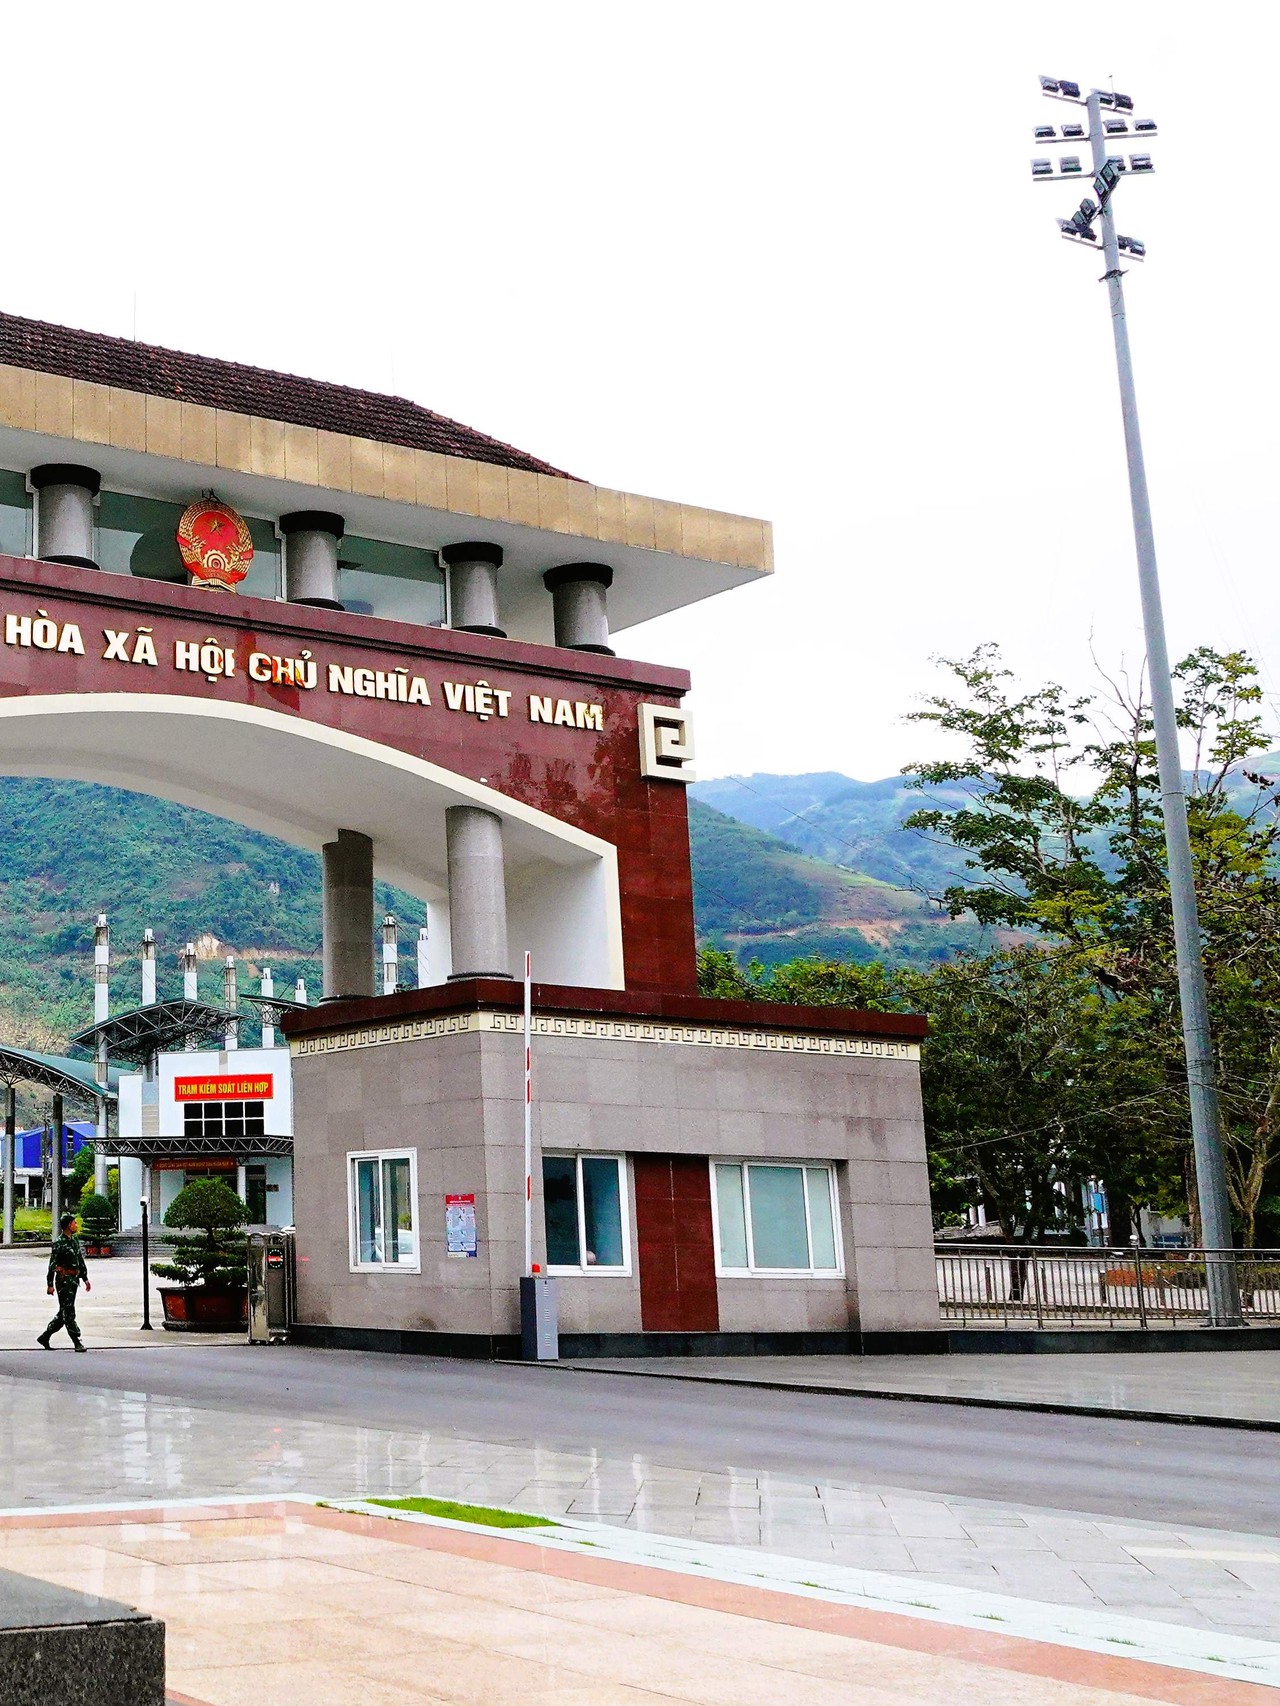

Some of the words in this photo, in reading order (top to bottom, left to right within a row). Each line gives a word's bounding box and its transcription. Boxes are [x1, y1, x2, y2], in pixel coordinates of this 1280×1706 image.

[5, 610, 85, 655] HÒA
[102, 627, 158, 666] XÃ
[175, 637, 236, 682] HỘI
[248, 650, 318, 689] CHỦ
[328, 664, 431, 707] NGHĨA
[443, 680, 512, 720] VIỆT
[530, 694, 603, 731] NAM
[178, 1084, 198, 1097] TRẠM
[218, 1081, 235, 1094] SOÁT
[237, 1080, 253, 1093] LIÊN
